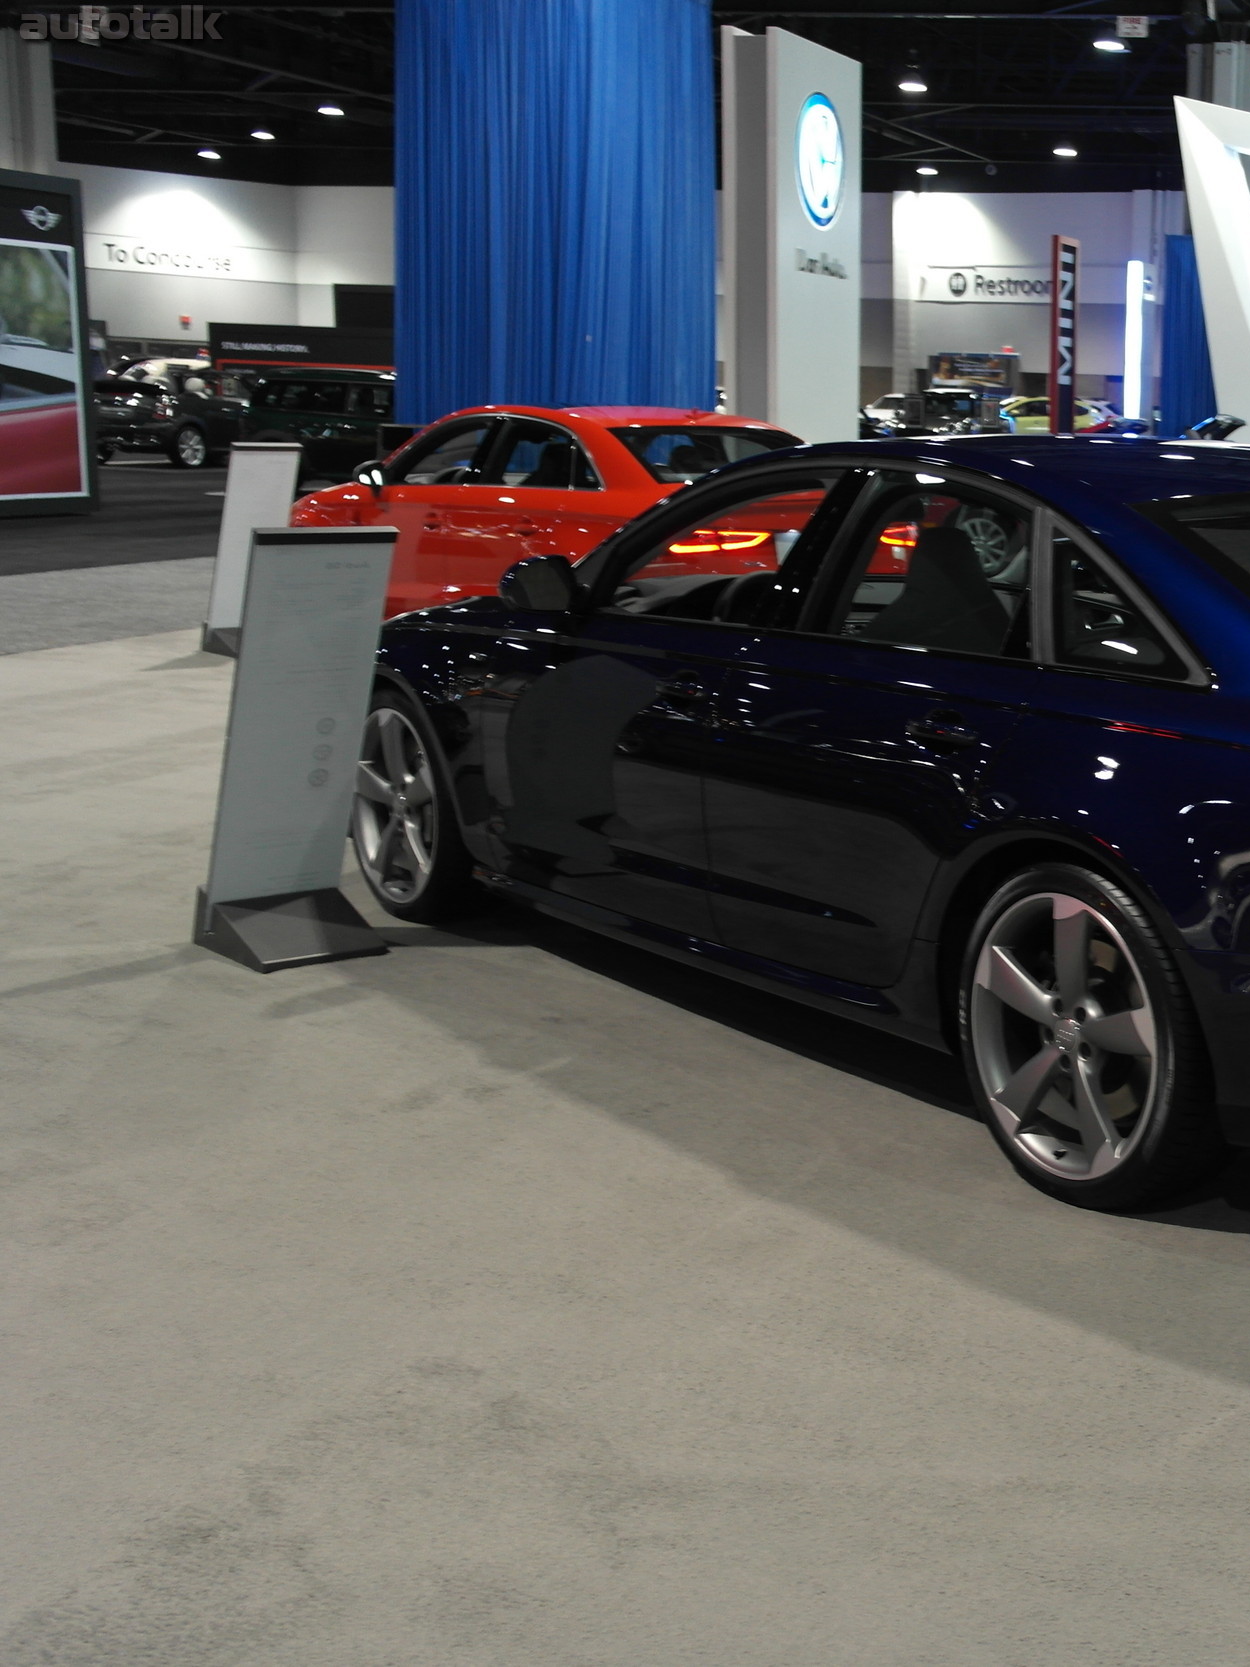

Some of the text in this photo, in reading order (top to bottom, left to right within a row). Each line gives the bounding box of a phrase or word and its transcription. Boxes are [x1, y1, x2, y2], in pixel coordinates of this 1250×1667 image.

[103, 242, 231, 272] To Concose
[1057, 251, 1074, 386] MINI
